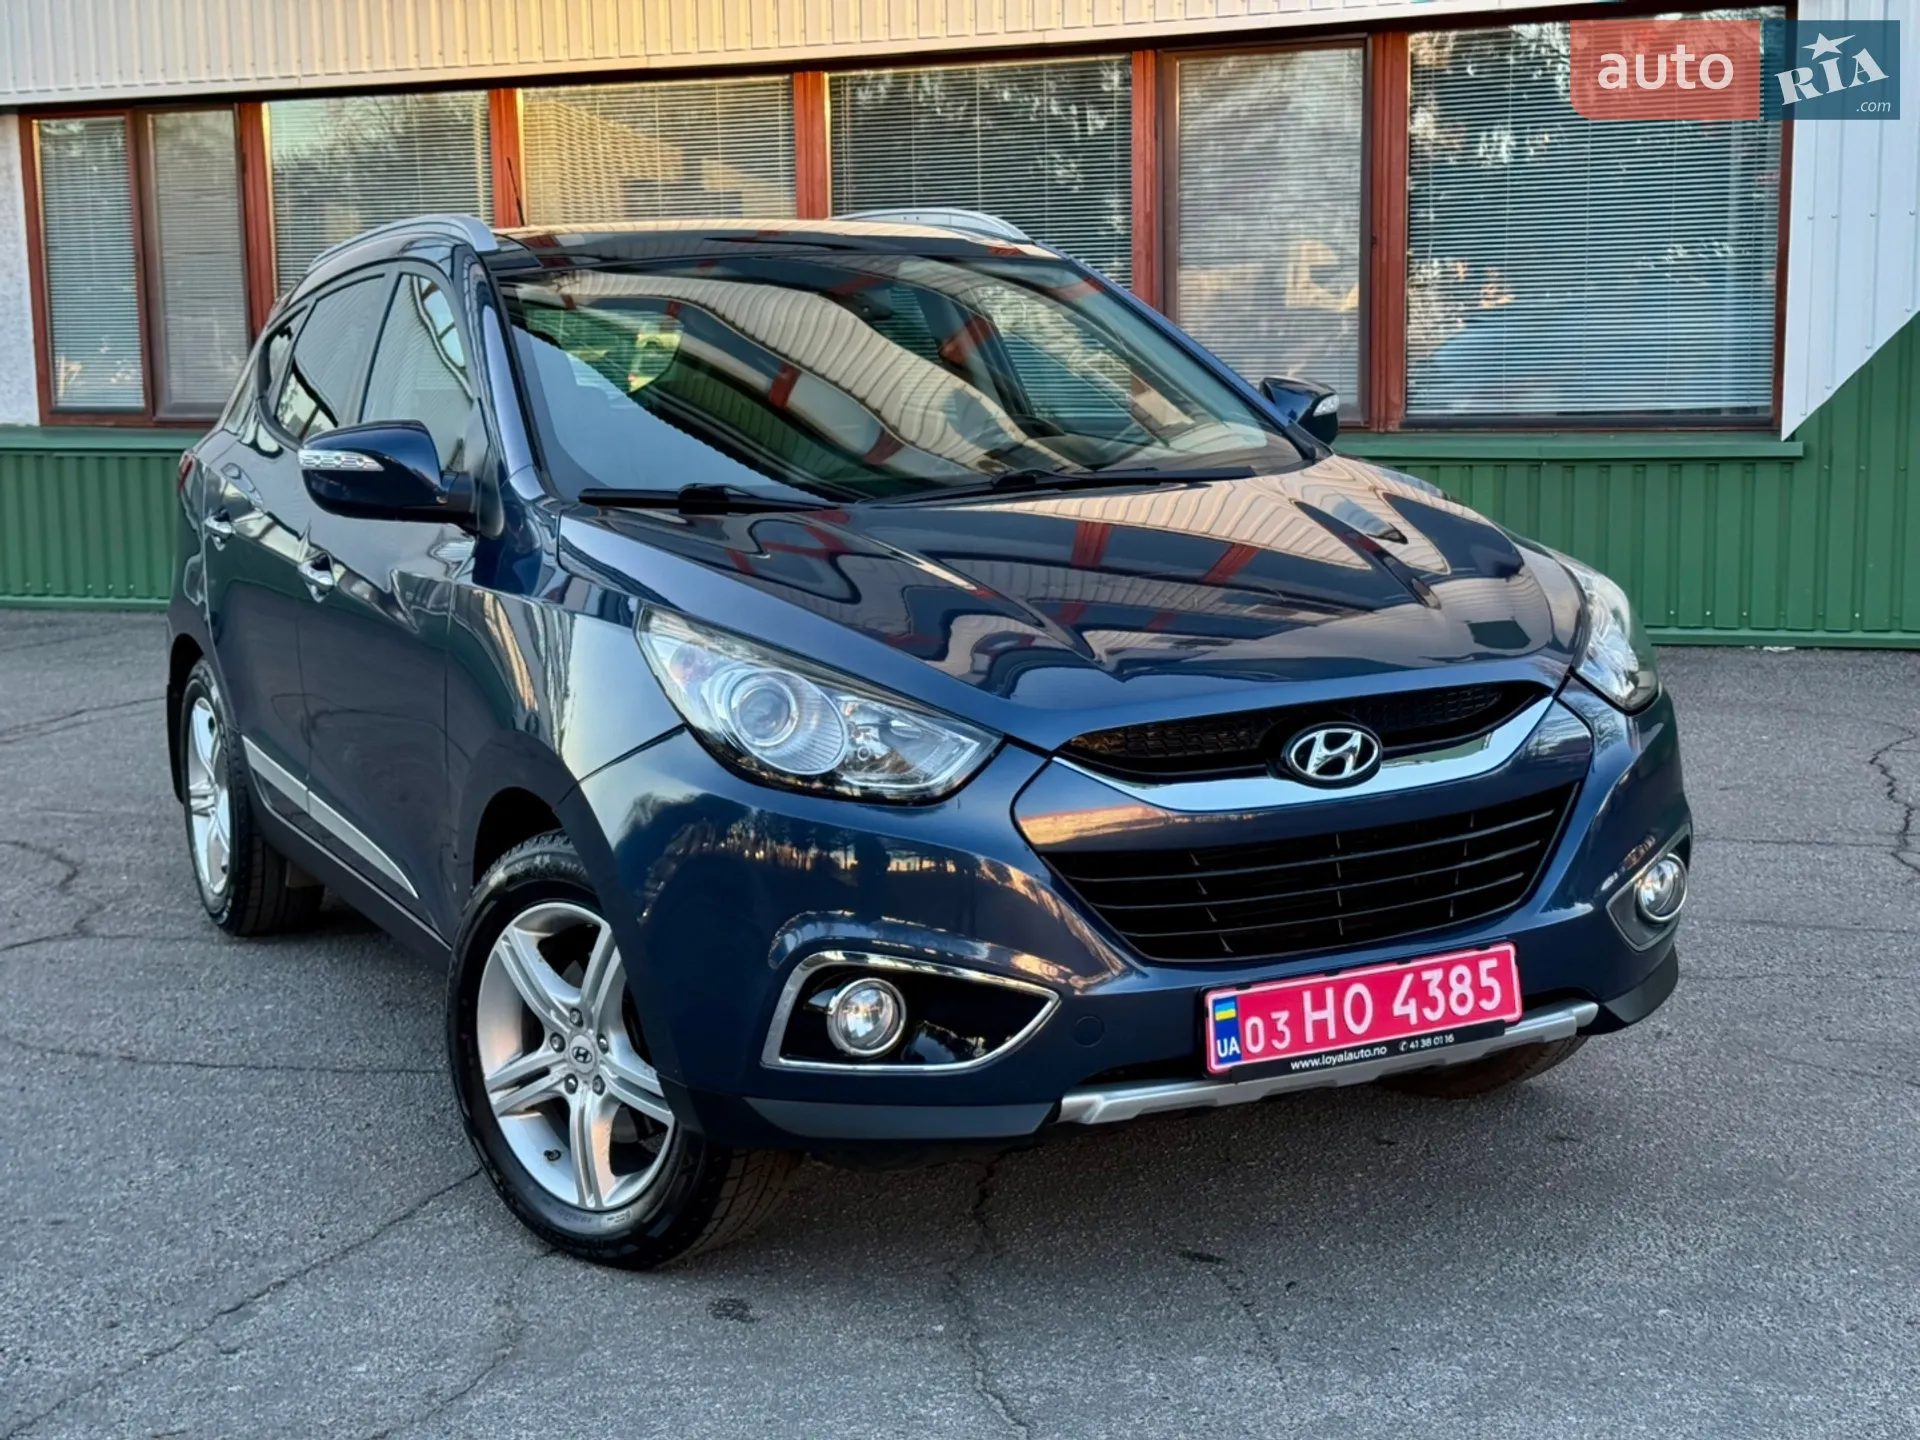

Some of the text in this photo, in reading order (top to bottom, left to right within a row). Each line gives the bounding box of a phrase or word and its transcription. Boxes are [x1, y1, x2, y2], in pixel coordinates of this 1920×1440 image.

[1216, 958, 1502, 1058] UA 03 HO 4385
[1290, 1046, 1388, 1071] www.loyalauto.no
